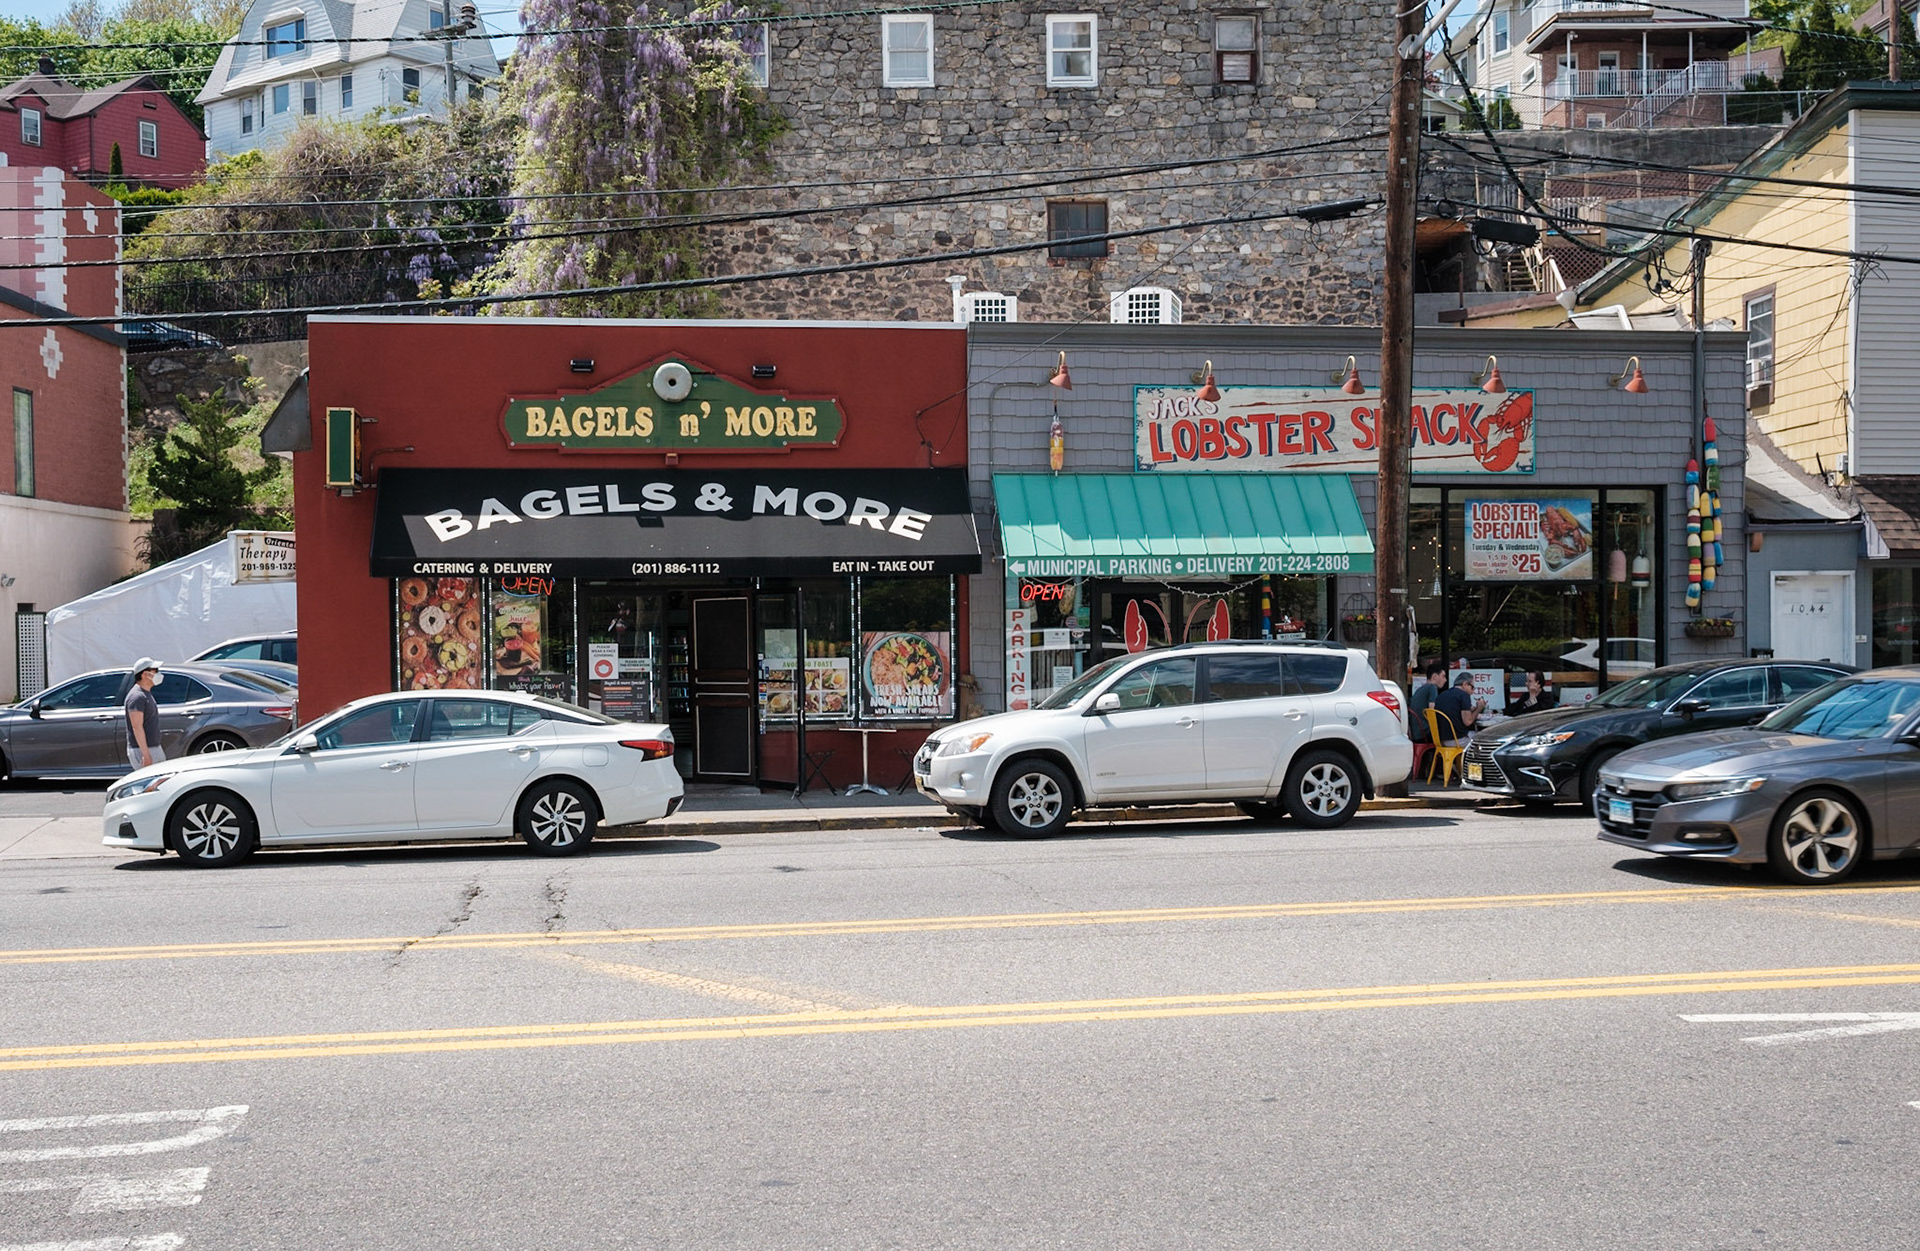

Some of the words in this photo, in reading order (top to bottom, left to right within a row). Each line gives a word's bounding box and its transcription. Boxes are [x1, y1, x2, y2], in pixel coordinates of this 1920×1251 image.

[526, 406, 654, 437] BAGELS
[680, 401, 711, 436] n'
[725, 406, 818, 437] MORE
[1147, 411, 1337, 462] LOBSTER
[1351, 402, 1484, 450] SACK
[424, 482, 677, 543] BAGELS
[695, 483, 733, 512] &
[752, 485, 933, 541] MORE
[1472, 504, 1538, 521] LOBSTER
[1472, 522, 1538, 539] SPECIAL!
[240, 546, 287, 561] Therapy
[1472, 543, 1496, 551] Tuesday
[1505, 543, 1539, 551] Wednesday
[413, 562, 475, 574] CATERING
[479, 563, 489, 574] &
[494, 562, 552, 574] DELIVERY
[632, 562, 663, 575] (201)
[665, 563, 720, 574] 886-1112
[833, 561, 854, 573] EAT
[857, 561, 869, 572] IN
[877, 560, 906, 572] TAKE
[908, 560, 934, 572] OUT
[1027, 558, 1103, 576] MUNICIPAL
[1109, 558, 1172, 575] PARKING
[1187, 556, 1254, 573] DELIVERY
[1259, 555, 1350, 571] 201-224-2808
[1512, 553, 1540, 573] $25
[501, 577, 554, 595] OPEN
[1021, 584, 1065, 601] OPEN
[1791, 604, 1824, 613] 1044
[1011, 611, 1026, 695] PARKING
[874, 684, 902, 695] FRESH
[906, 684, 939, 695] SALADS
[870, 696, 892, 707] NOW
[896, 695, 943, 707] AVAILABLE
